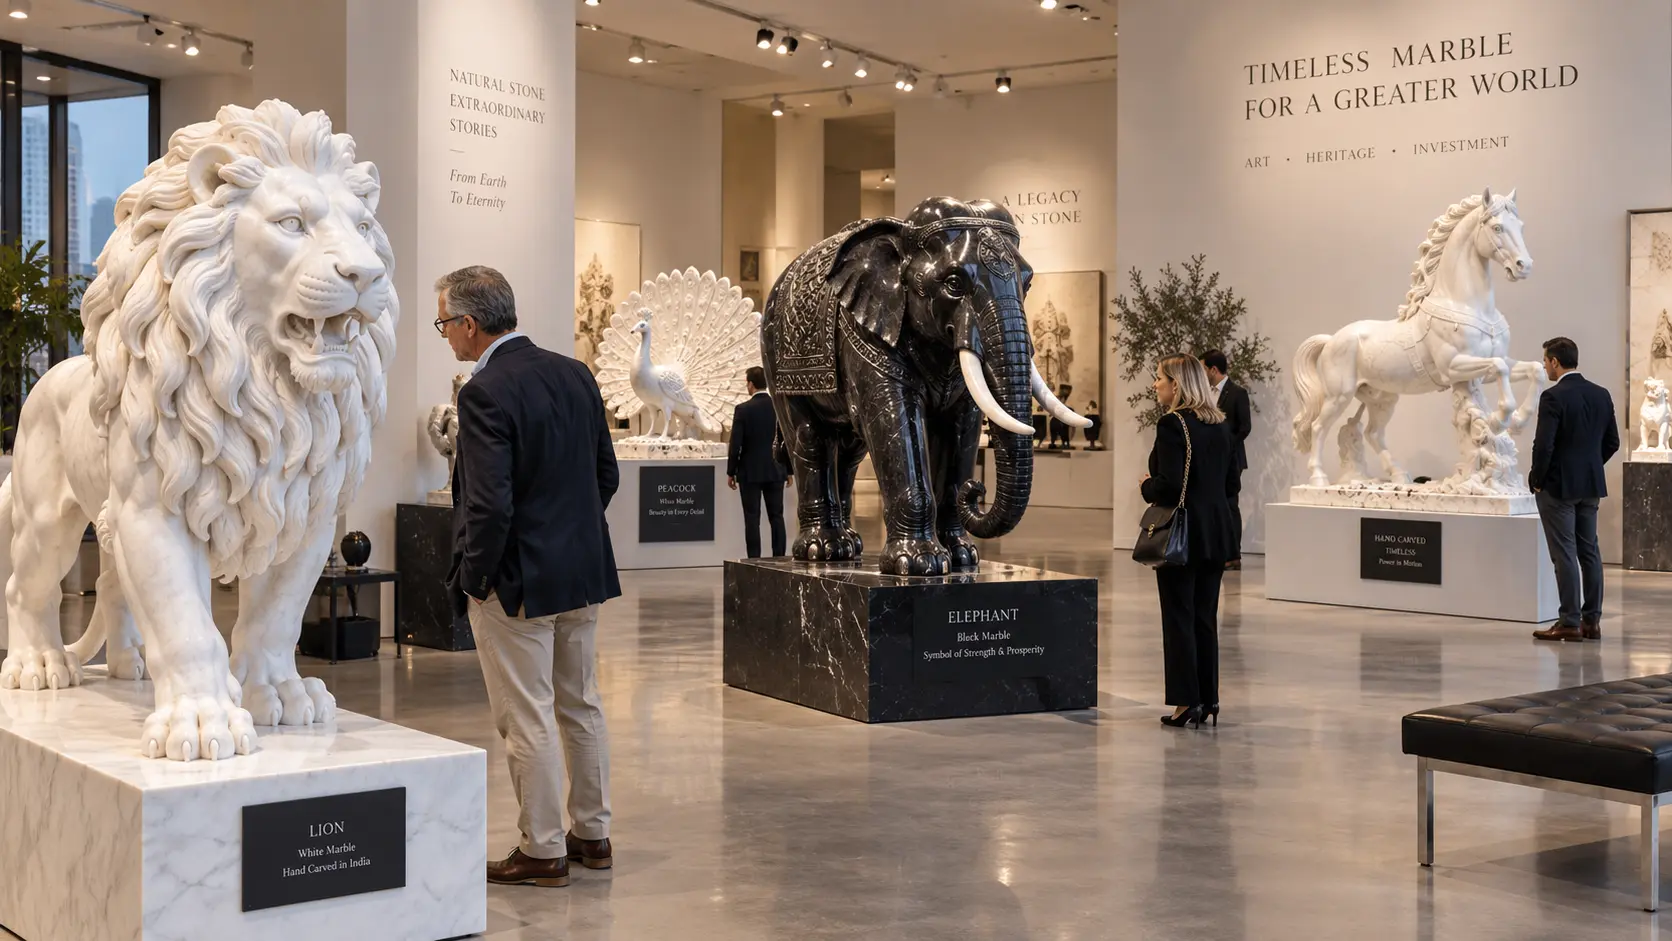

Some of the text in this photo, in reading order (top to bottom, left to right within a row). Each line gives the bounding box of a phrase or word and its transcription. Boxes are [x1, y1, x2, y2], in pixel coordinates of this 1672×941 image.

[1244, 32, 1514, 85] TIMELESS MARBLE
[450, 68, 545, 101] NATURAL STONE
[1245, 64, 1579, 120] FOR A GREATER WORLD
[450, 93, 546, 124] EXTRAORDINARY
[450, 118, 497, 138] STORIES
[1244, 136, 1510, 169] ART HERITAGE INVESTMENT
[450, 169, 507, 188] From Earth
[450, 191, 506, 212] To Eternity
[1002, 189, 1081, 206] A LEGACY
[1031, 210, 1082, 225] STONE
[657, 484, 696, 493] PEACOCK
[948, 608, 1019, 624] ELEPHANT
[981, 630, 1011, 641] Marble
[923, 645, 1045, 662] Symbol of Strength & Prosperity
[309, 821, 345, 838] LION
[298, 842, 356, 858] White Marble
[282, 856, 371, 878] Hand Carved in India
